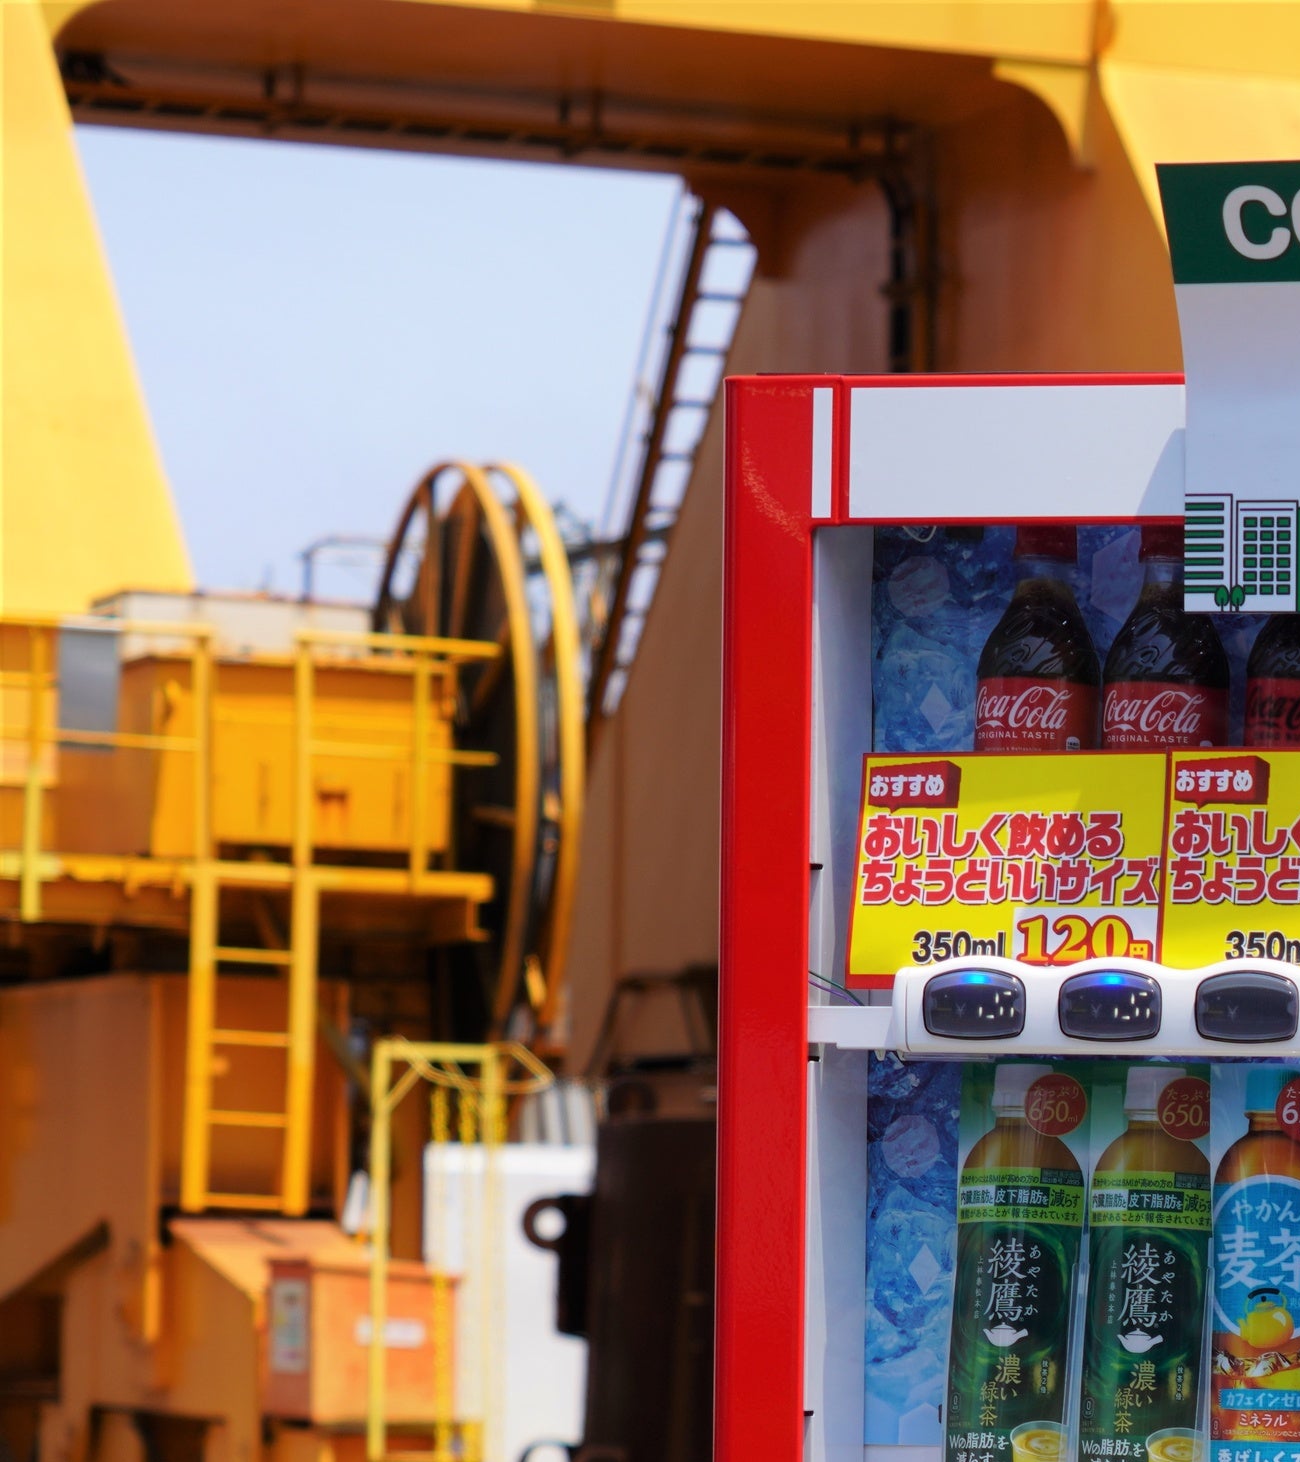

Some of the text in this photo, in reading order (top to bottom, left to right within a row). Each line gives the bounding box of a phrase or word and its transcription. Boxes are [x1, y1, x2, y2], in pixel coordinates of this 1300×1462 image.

[975, 686, 1075, 734] Coca-Cola
[1103, 688, 1202, 736] Coca-Cola
[978, 731, 1056, 741] ORIGINAL TASTE
[870, 774, 944, 797] おすすめ
[864, 812, 1122, 860] おいしく飲める
[862, 858, 1160, 906] ちょうどいいサイズ
[912, 915, 1151, 966] 350ml 120円
[984, 1238, 1027, 1321] 綾鷹
[1025, 1245, 1041, 1316] あやたか
